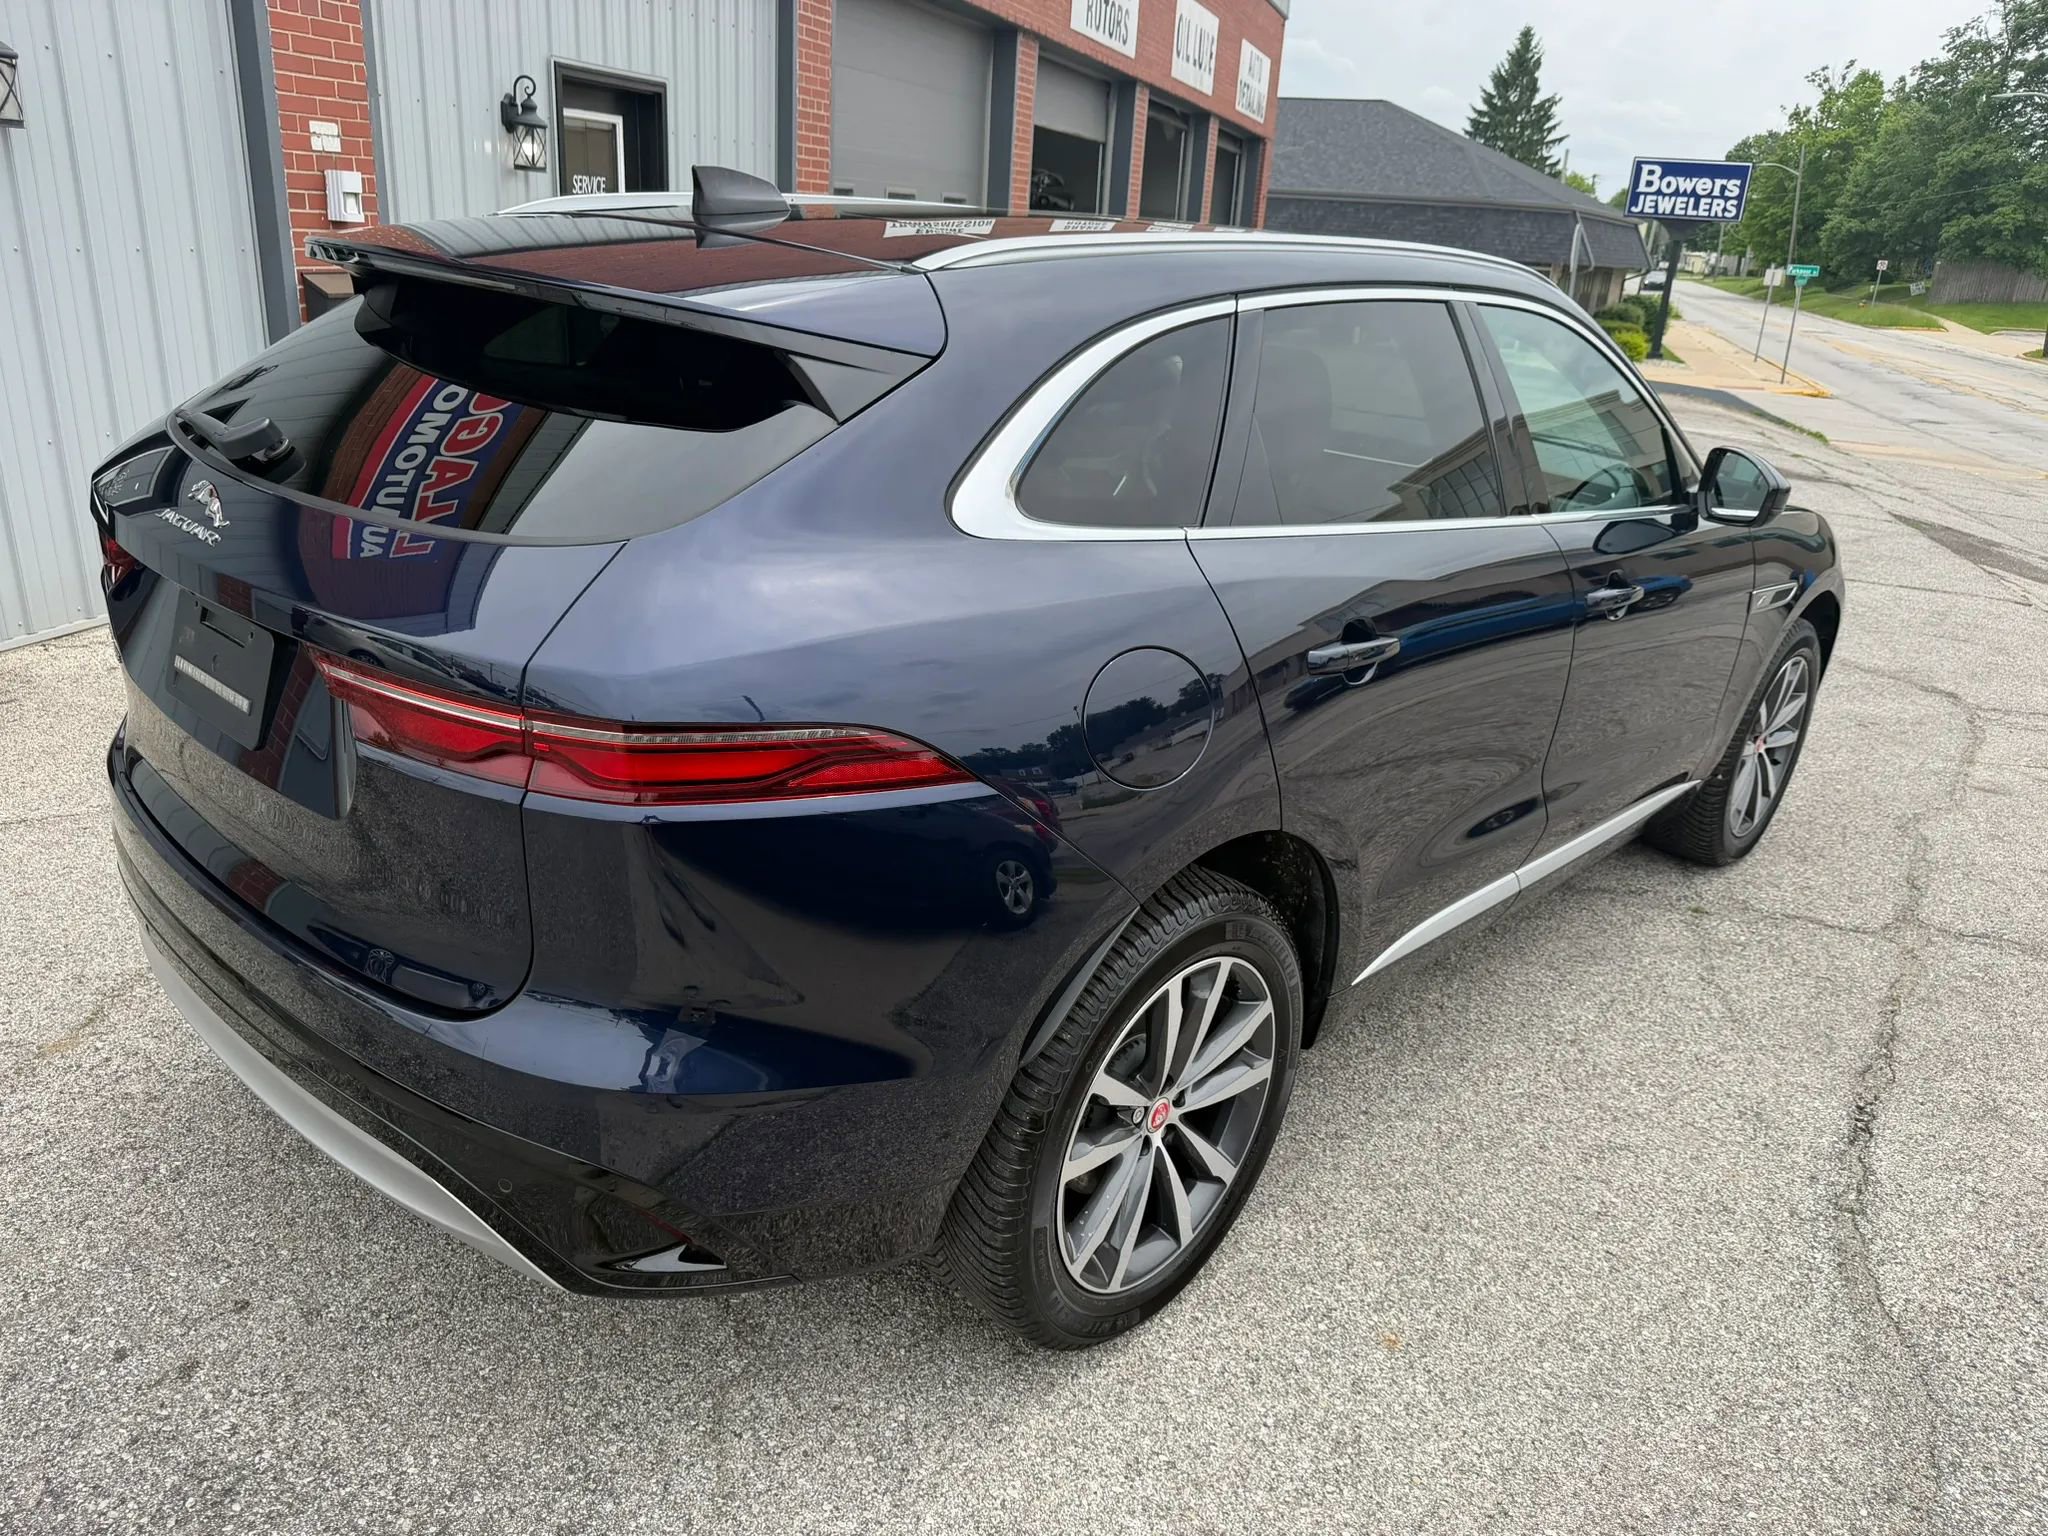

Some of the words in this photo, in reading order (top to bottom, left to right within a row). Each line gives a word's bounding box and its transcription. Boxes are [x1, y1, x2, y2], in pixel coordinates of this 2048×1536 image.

[1085, 0, 1130, 46] ROTORS
[1176, 14, 1191, 64] OIL
[572, 174, 606, 194] SERVICE
[1630, 195, 1739, 219] JEWELERS
[155, 508, 222, 547] JAGUAR
